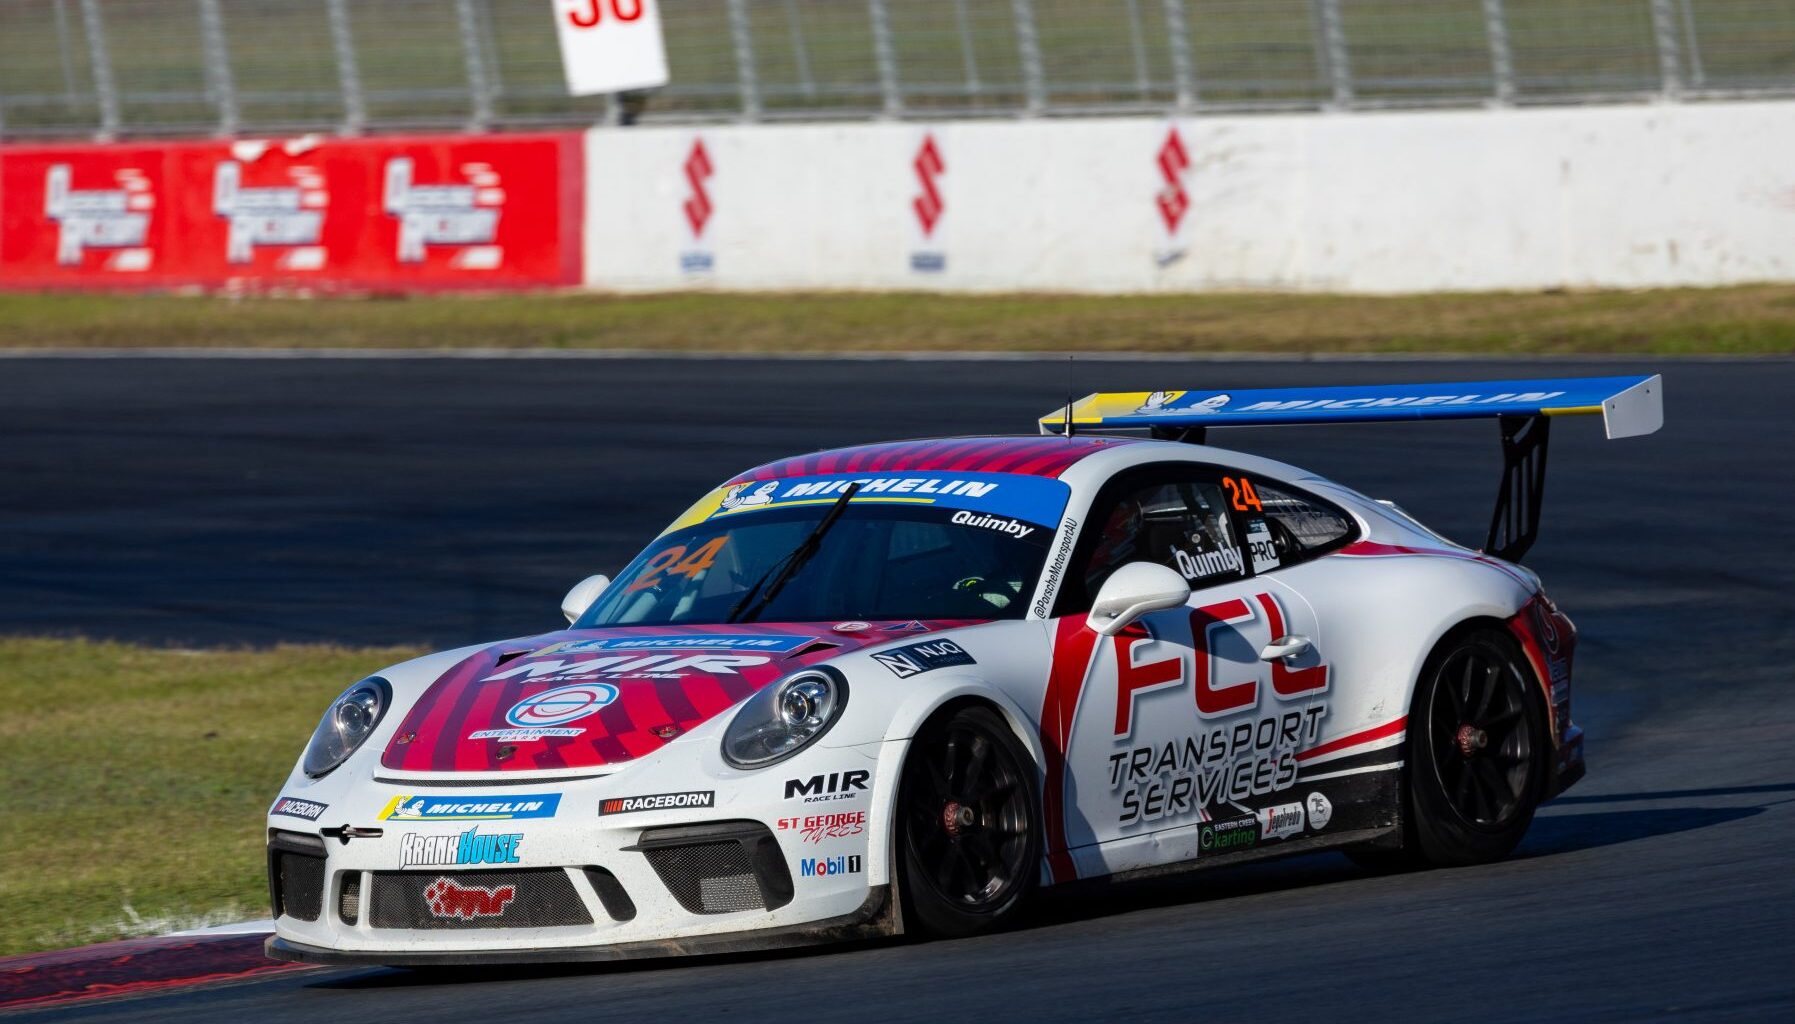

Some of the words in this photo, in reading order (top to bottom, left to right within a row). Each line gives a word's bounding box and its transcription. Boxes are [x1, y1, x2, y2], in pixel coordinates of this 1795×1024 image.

[1234, 391, 1566, 411] MICHELIN
[781, 478, 999, 499] MICHELIN
[1222, 476, 1263, 512] 24
[951, 510, 1037, 539] Quimby
[1175, 542, 1246, 580] Quimby
[1250, 539, 1279, 563] PRO
[623, 533, 730, 594] 24
[1033, 518, 1078, 619] @PorscheMotorsportAU
[610, 638, 784, 649] MICHELIN
[913, 642, 964, 658] NJQ
[480, 654, 771, 682] MIR
[1113, 592, 1328, 736] FCL
[520, 673, 607, 684] RACE
[472, 729, 583, 738] ENTERTAINMENT
[1110, 706, 1324, 784] TRANSPORT
[784, 769, 871, 800] MIR
[1119, 752, 1297, 822] SERVICES
[280, 799, 323, 819] RACEBORN
[426, 801, 545, 815] MICHELIN
[621, 793, 712, 811] RACEBORN
[804, 795, 835, 803] RACE
[777, 818, 801, 830] ST
[804, 811, 866, 828] GEORGE
[1214, 820, 1239, 832] EASTERN
[1238, 818, 1256, 828] CREEK
[799, 823, 864, 845] TYRES
[1214, 829, 1256, 848] karting
[801, 856, 845, 877] Mobil
[849, 855, 860, 873] 1
